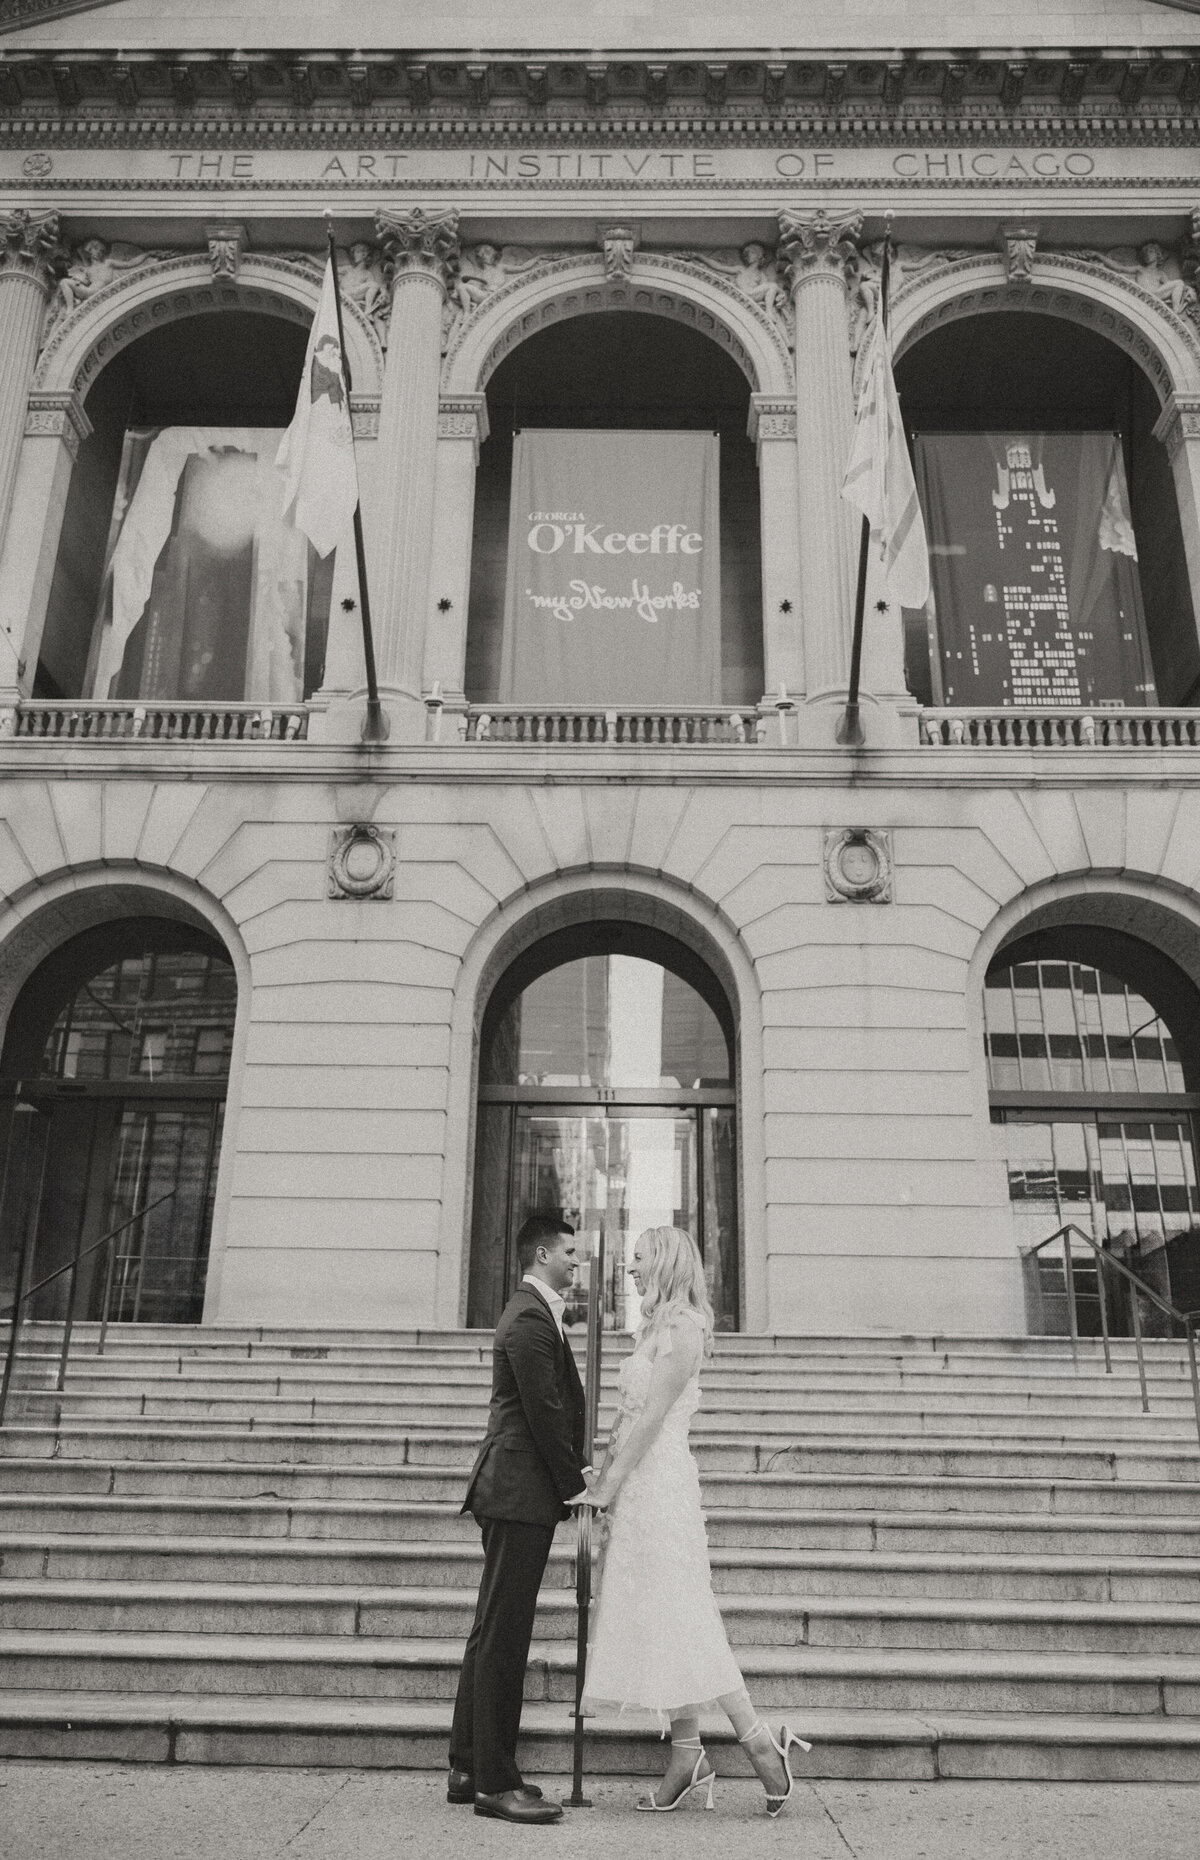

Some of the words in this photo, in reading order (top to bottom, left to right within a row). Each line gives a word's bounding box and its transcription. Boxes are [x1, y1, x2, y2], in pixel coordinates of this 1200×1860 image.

[170, 154, 255, 178] THE
[321, 154, 409, 178] ART
[469, 154, 716, 178] INSTITVTE
[775, 153, 835, 177] OF
[892, 153, 1095, 177] CHICAGO
[528, 512, 585, 521] GEORGIA
[527, 523, 703, 554] O'Keeffe
[569, 580, 633, 609] New
[597, 1090, 615, 1101] 111
